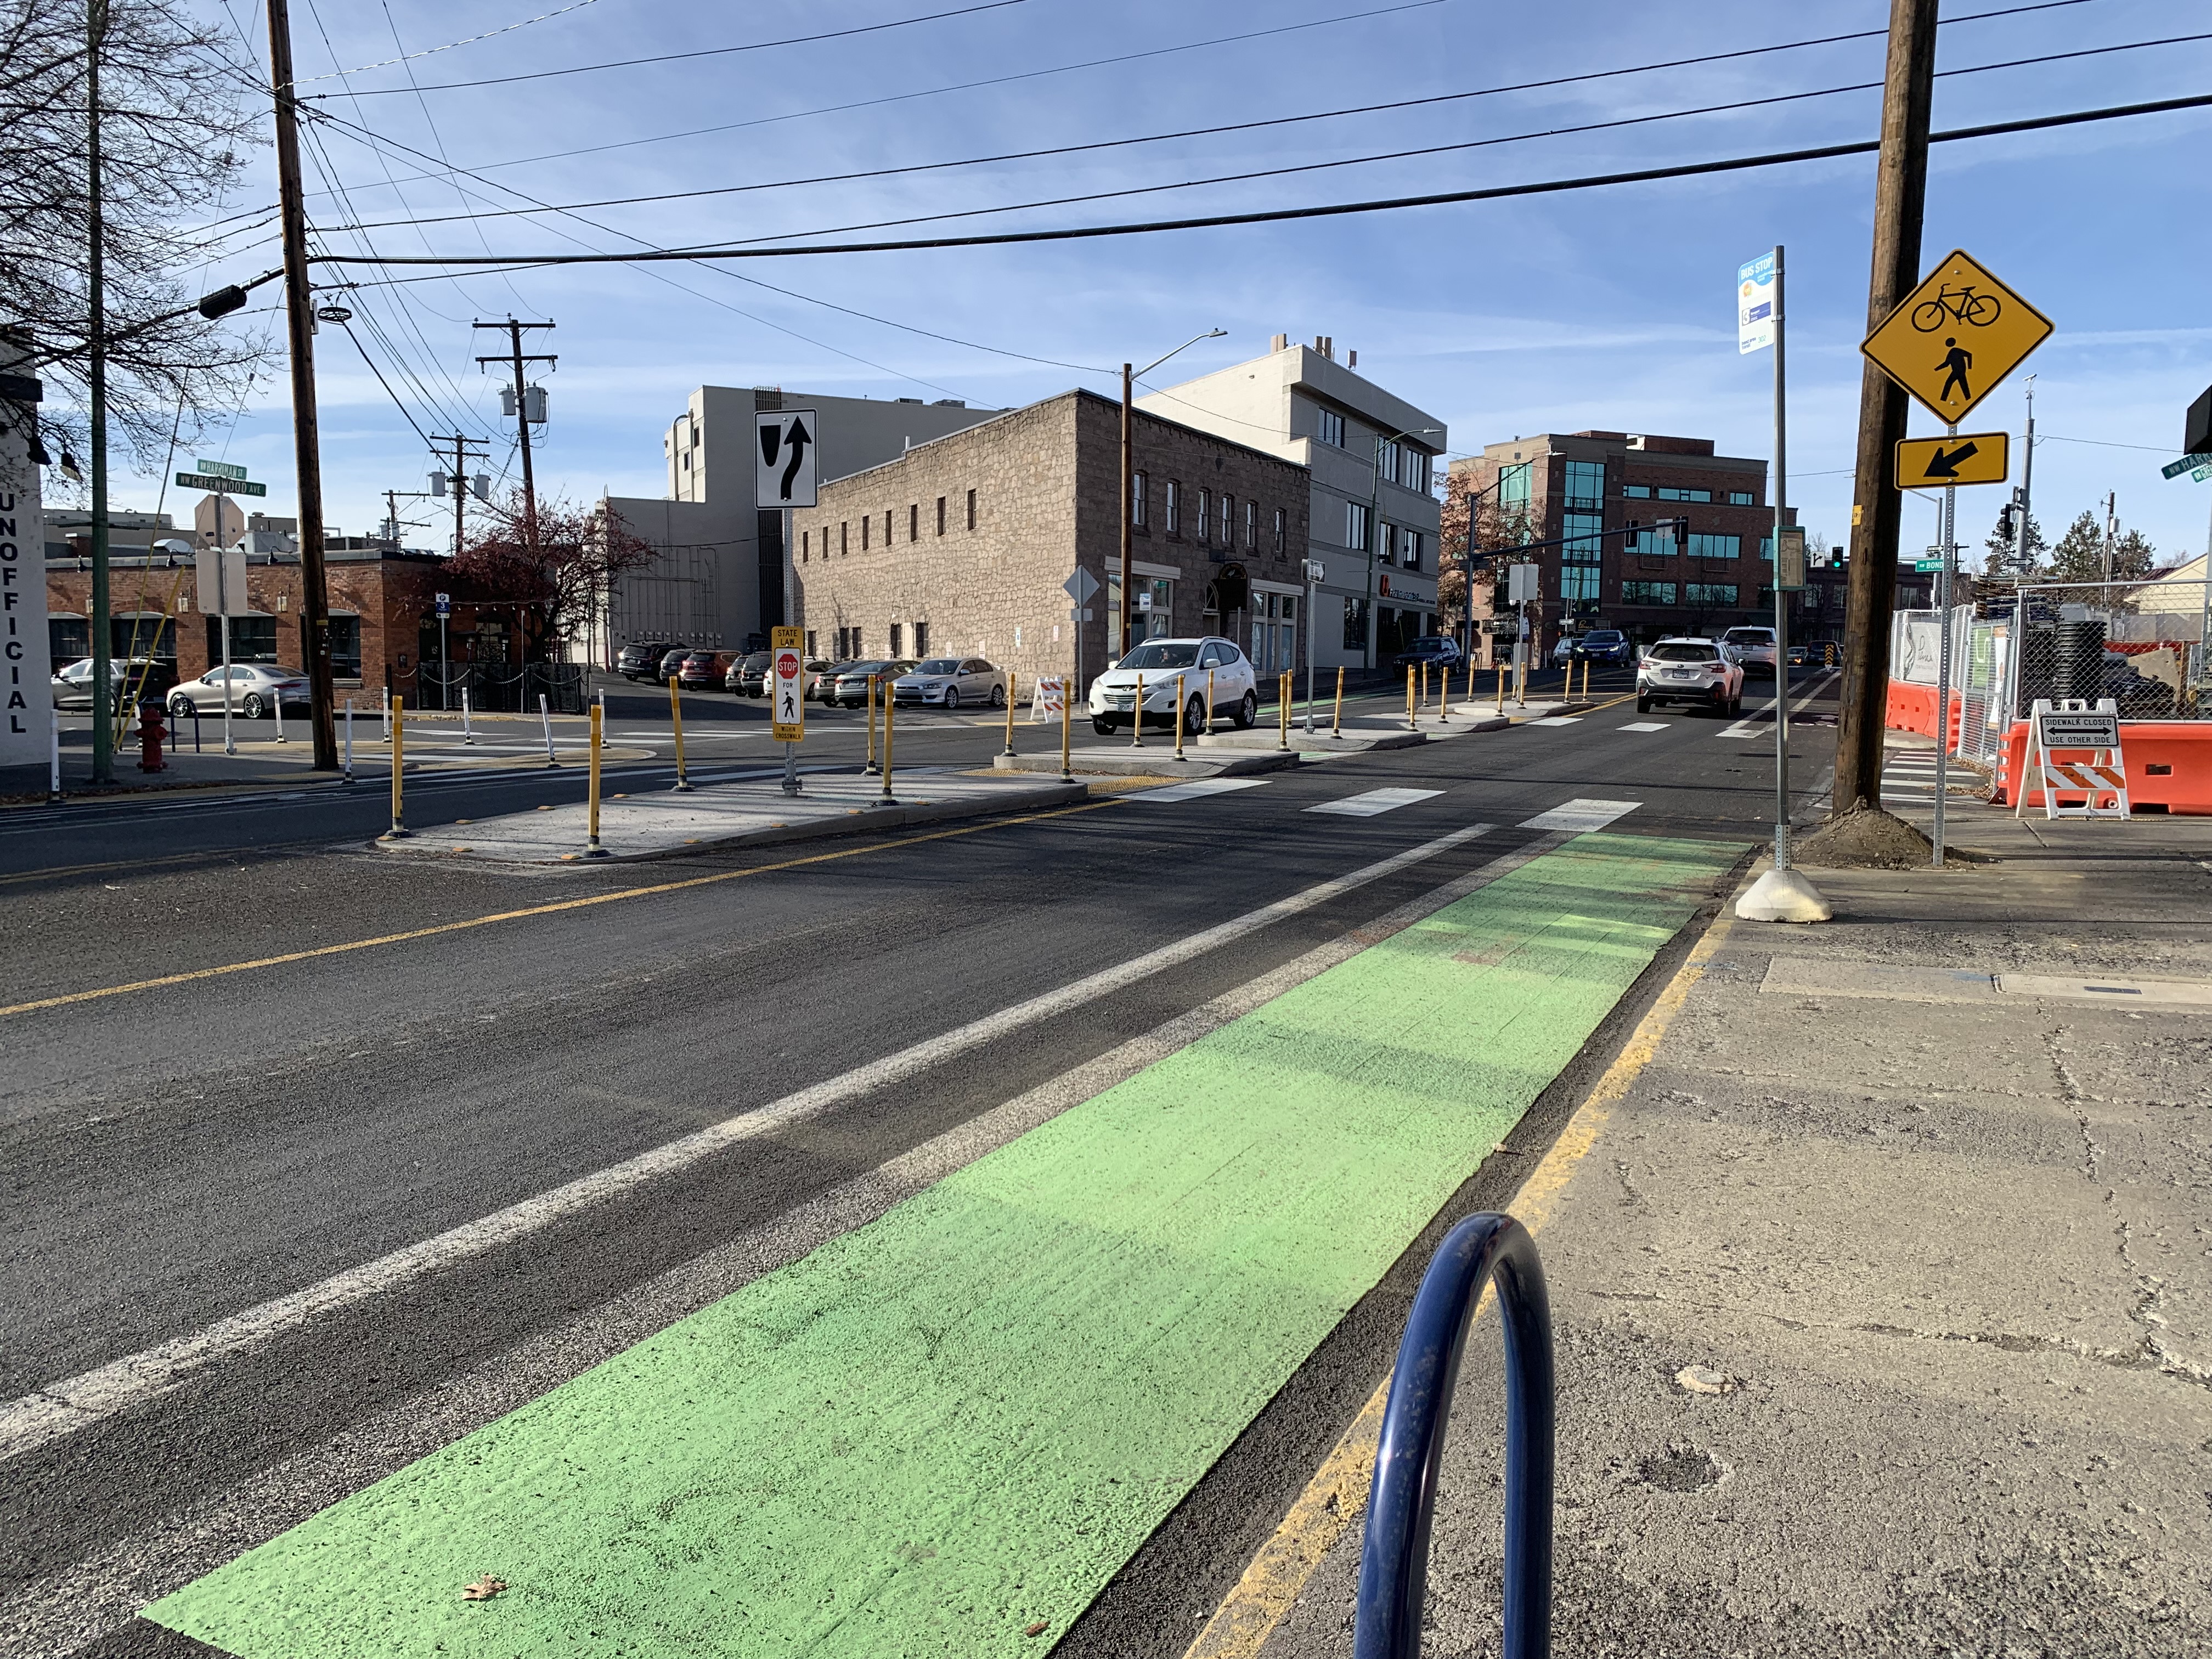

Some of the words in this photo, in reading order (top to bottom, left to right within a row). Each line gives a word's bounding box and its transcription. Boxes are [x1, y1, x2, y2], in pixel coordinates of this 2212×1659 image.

[1741, 265, 1754, 280] BUS
[1755, 256, 1773, 274] STOP
[1742, 308, 1750, 325] 3
[200, 461, 206, 471] NW
[206, 462, 238, 478] HARRIMAN
[238, 469, 243, 477] ST
[2169, 464, 2181, 475] NW
[180, 476, 190, 484] NW
[192, 476, 247, 493] GREENWOOD
[249, 484, 261, 494] AVE
[0, 493, 27, 733] UNOFFICIAL
[778, 662, 797, 672] STOP
